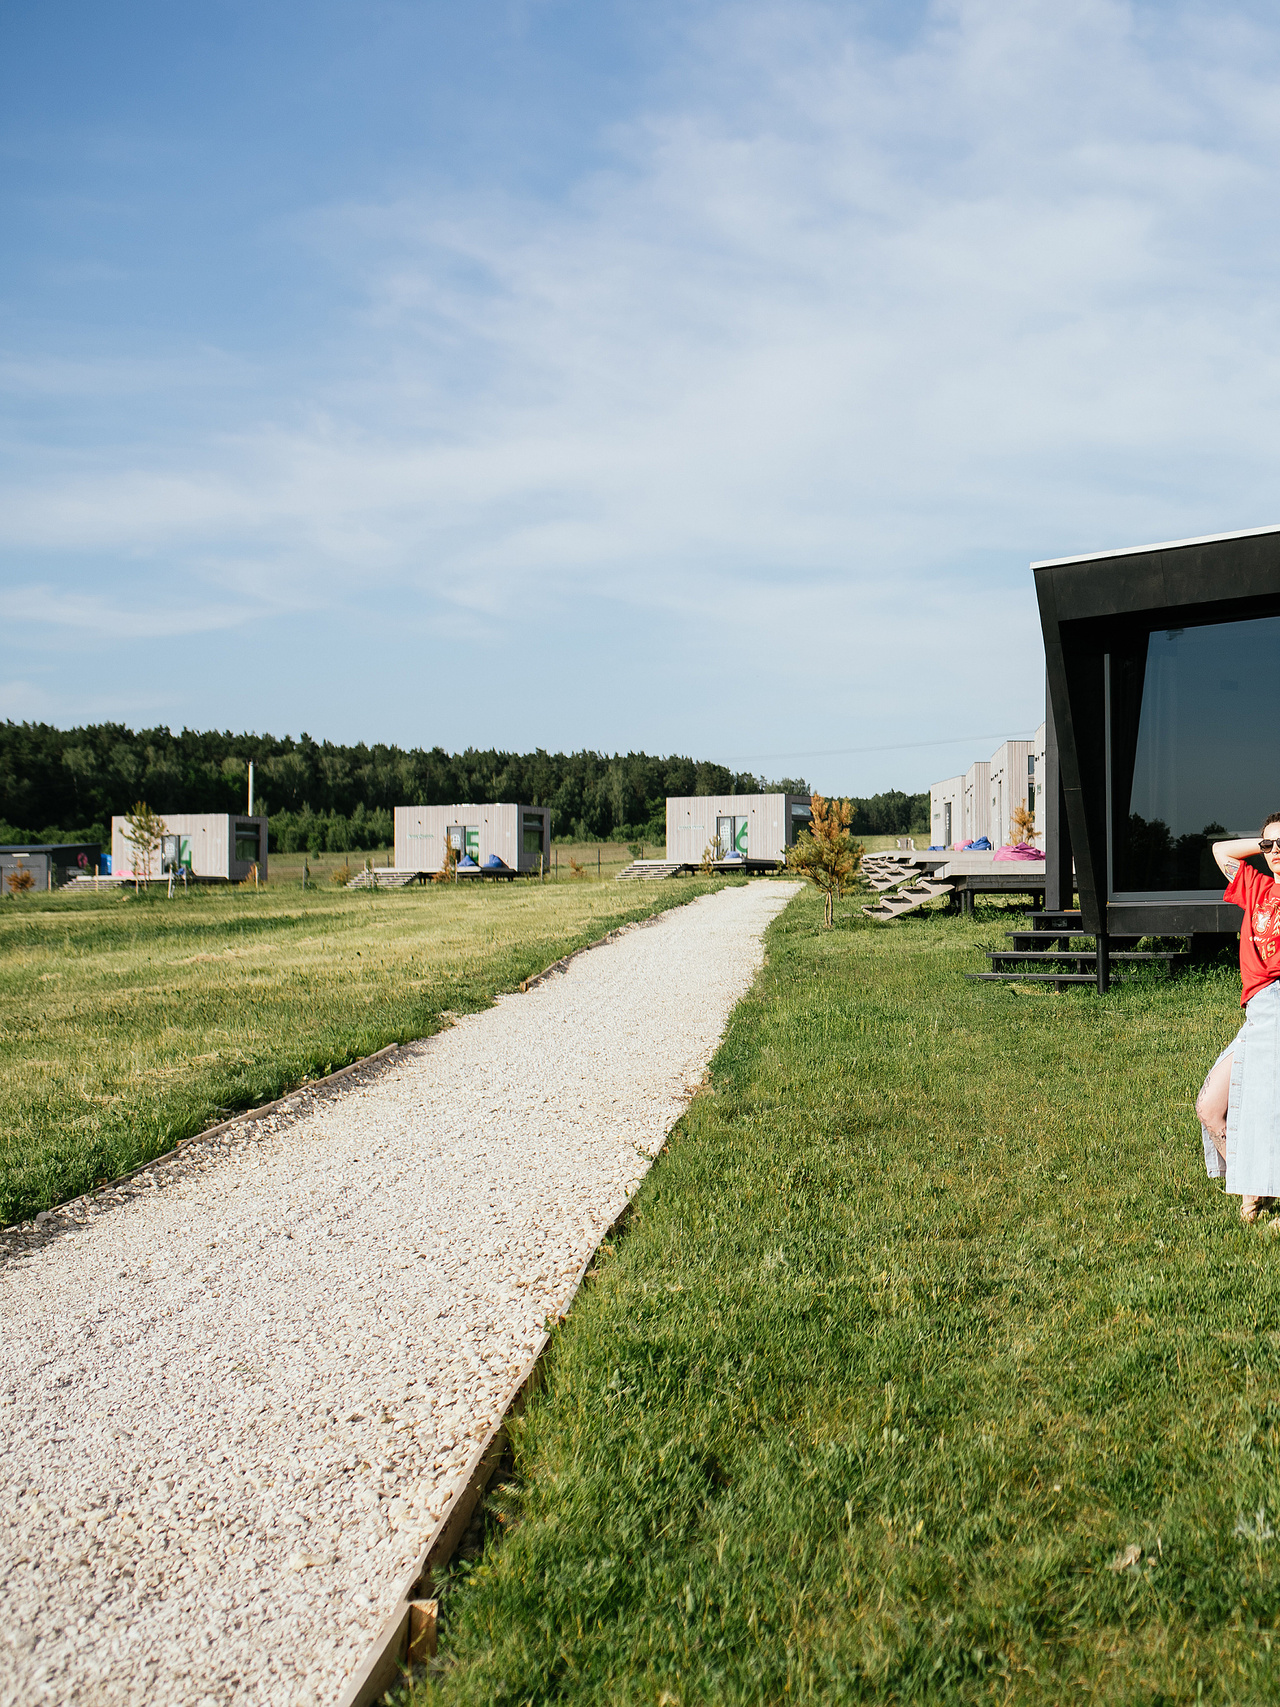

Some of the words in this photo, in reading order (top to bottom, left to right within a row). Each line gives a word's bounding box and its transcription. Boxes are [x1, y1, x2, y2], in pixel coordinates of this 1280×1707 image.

[466, 831, 479, 861] 5
[735, 821, 748, 854] 6
[180, 840, 192, 869] 4
[1257, 940, 1276, 960] AS
